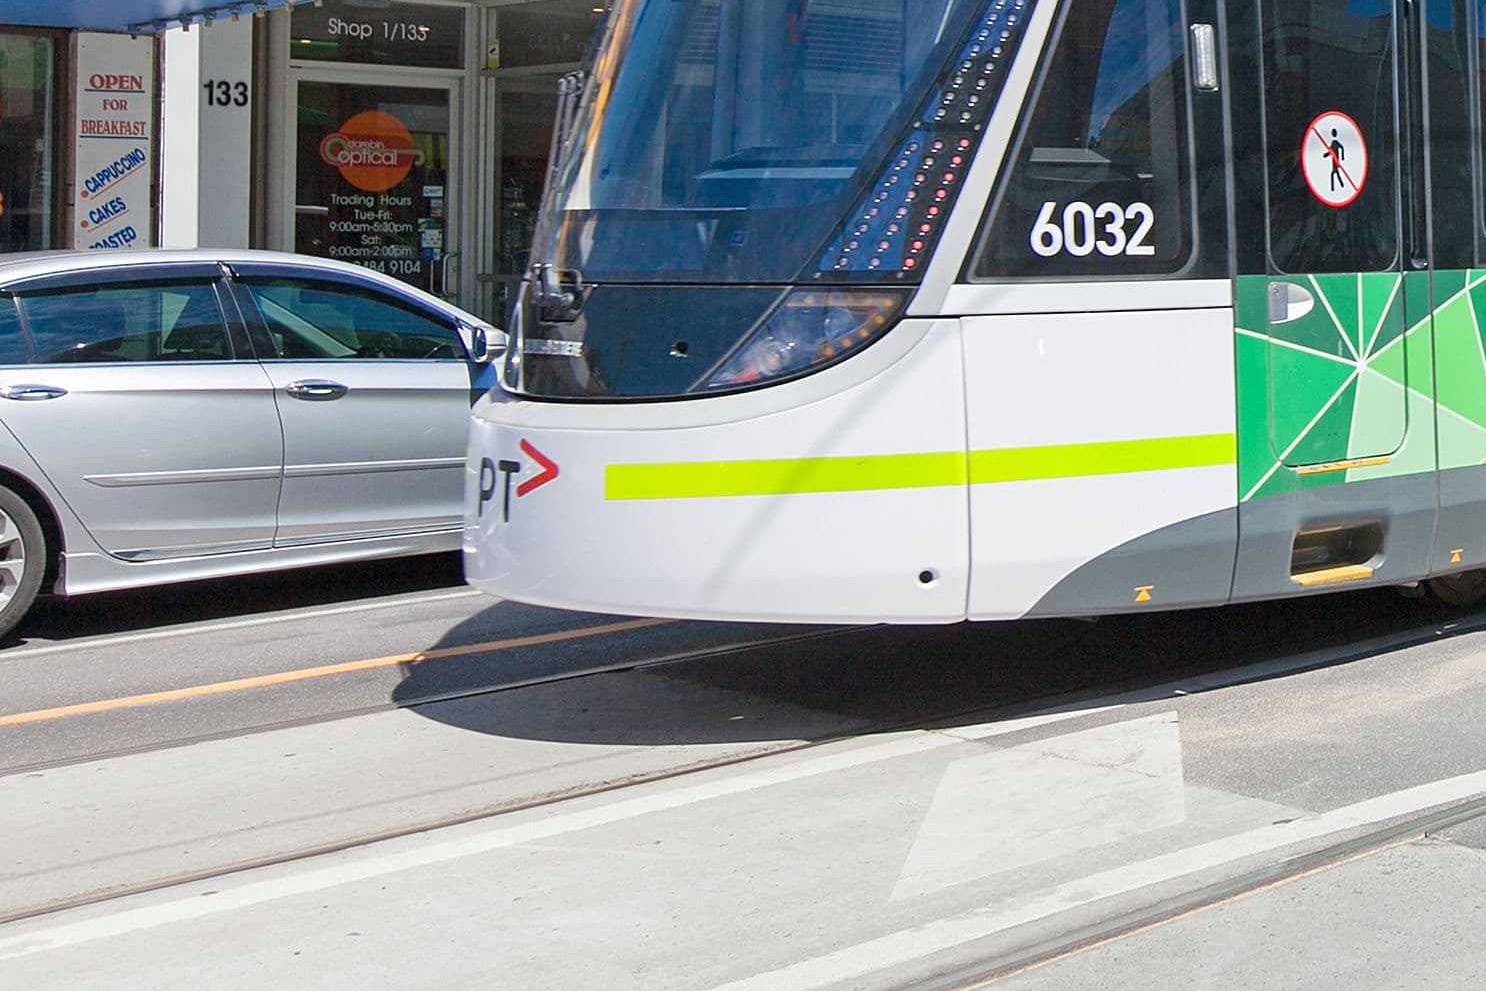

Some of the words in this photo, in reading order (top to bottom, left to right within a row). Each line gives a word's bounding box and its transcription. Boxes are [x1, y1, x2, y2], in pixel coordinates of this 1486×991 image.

[328, 18, 373, 40] Shop
[382, 21, 428, 42] 1/133
[89, 74, 143, 90] OPEN
[203, 80, 249, 107] 133
[102, 99, 128, 111] FOR
[81, 119, 147, 136] BREAKFAST
[337, 149, 398, 167] optical
[84, 148, 146, 193] CAPPUCCINO
[89, 197, 127, 225] CAKES
[331, 194, 375, 208] Trading
[380, 195, 412, 207] Hours
[88, 226, 137, 249] OASTED
[1029, 201, 1156, 257] 6032
[389, 260, 421, 274] 9104
